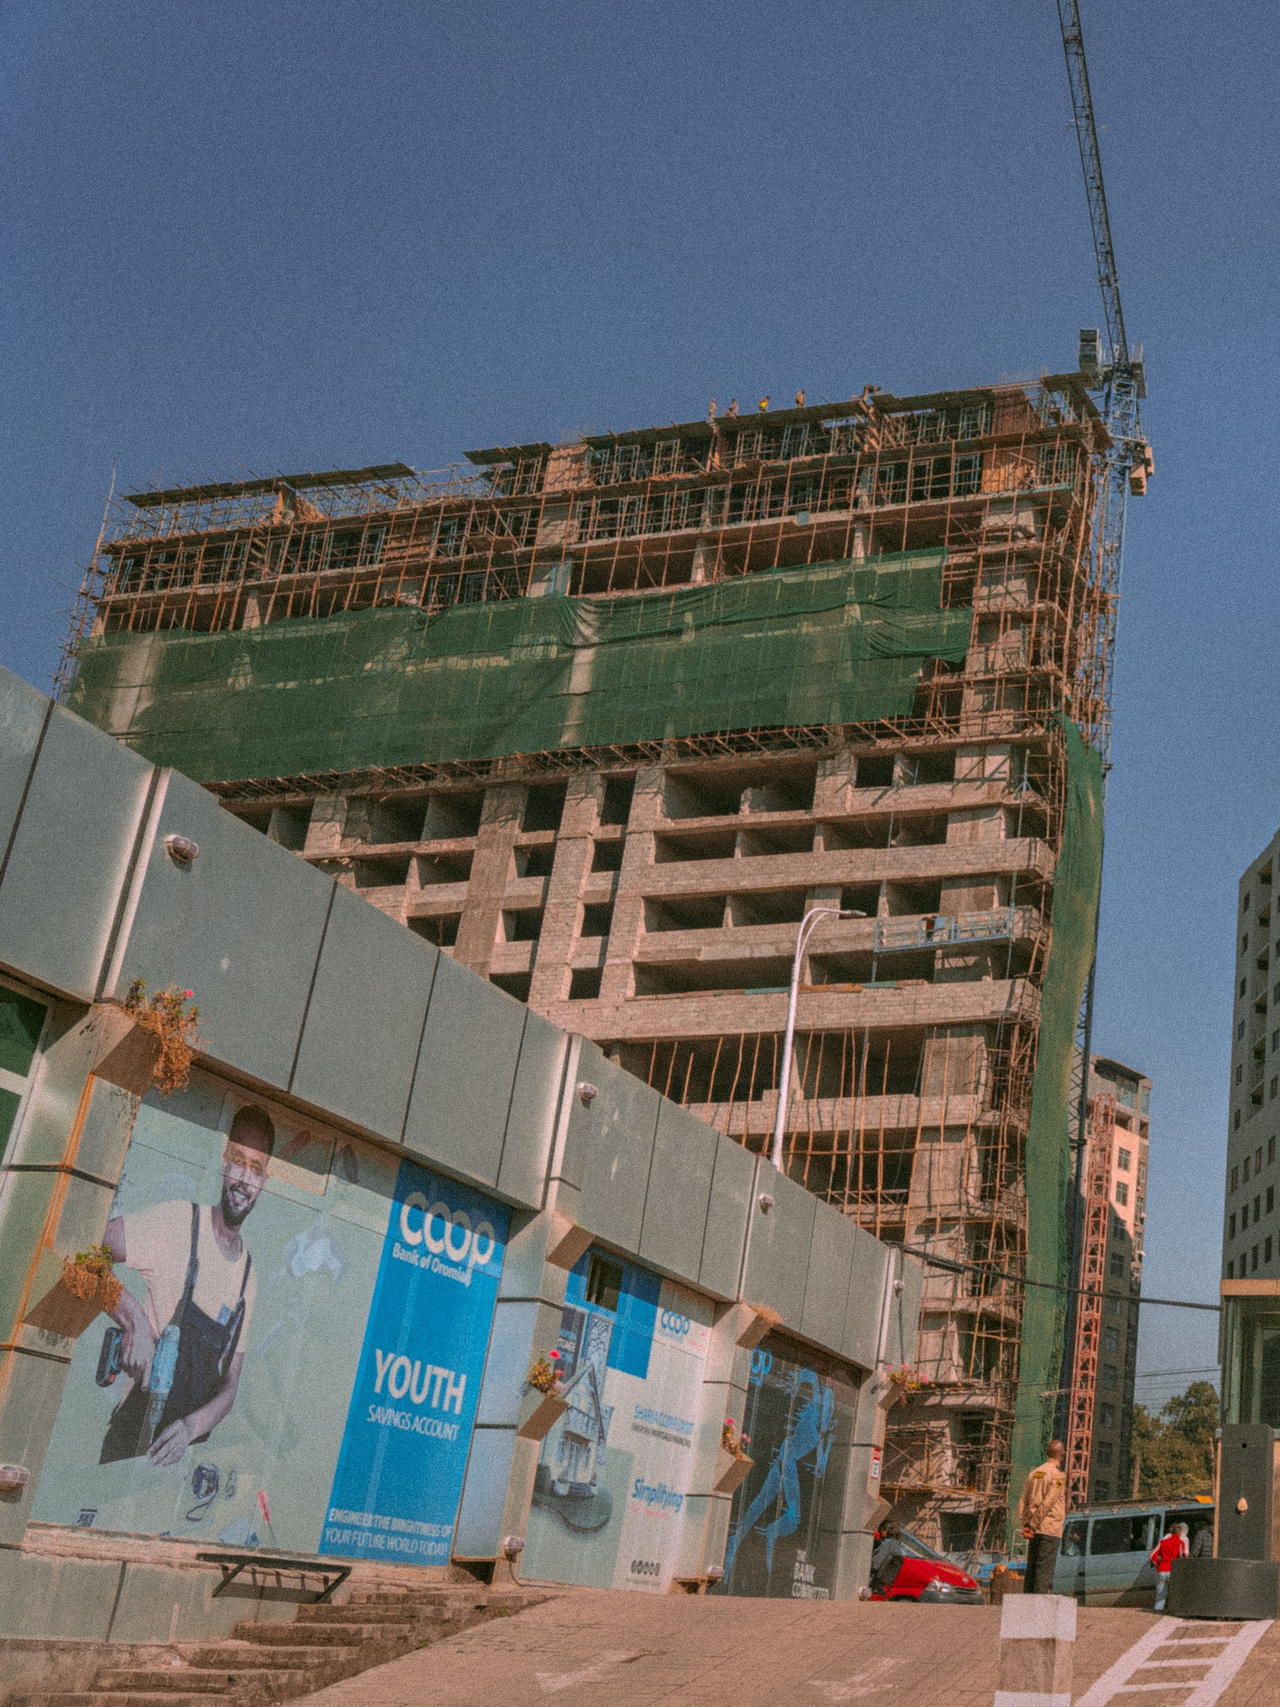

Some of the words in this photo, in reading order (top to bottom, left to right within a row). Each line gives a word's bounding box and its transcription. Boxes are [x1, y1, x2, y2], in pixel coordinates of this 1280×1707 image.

[393, 1242, 419, 1266] Bank
[420, 1254, 432, 1270] of
[431, 1258, 467, 1284] Oromia
[374, 1349, 467, 1415] YOUTH
[367, 1405, 412, 1431] SAVINGS
[411, 1416, 460, 1441] ACCOUNT
[632, 1478, 684, 1513] Simplifying
[325, 1527, 351, 1545] YOUR
[352, 1531, 385, 1549] FUTURE
[386, 1536, 419, 1554] WORLD
[374, 1514, 391, 1530] THE
[440, 1524, 453, 1538] OF
[793, 1562, 816, 1584] BANK
